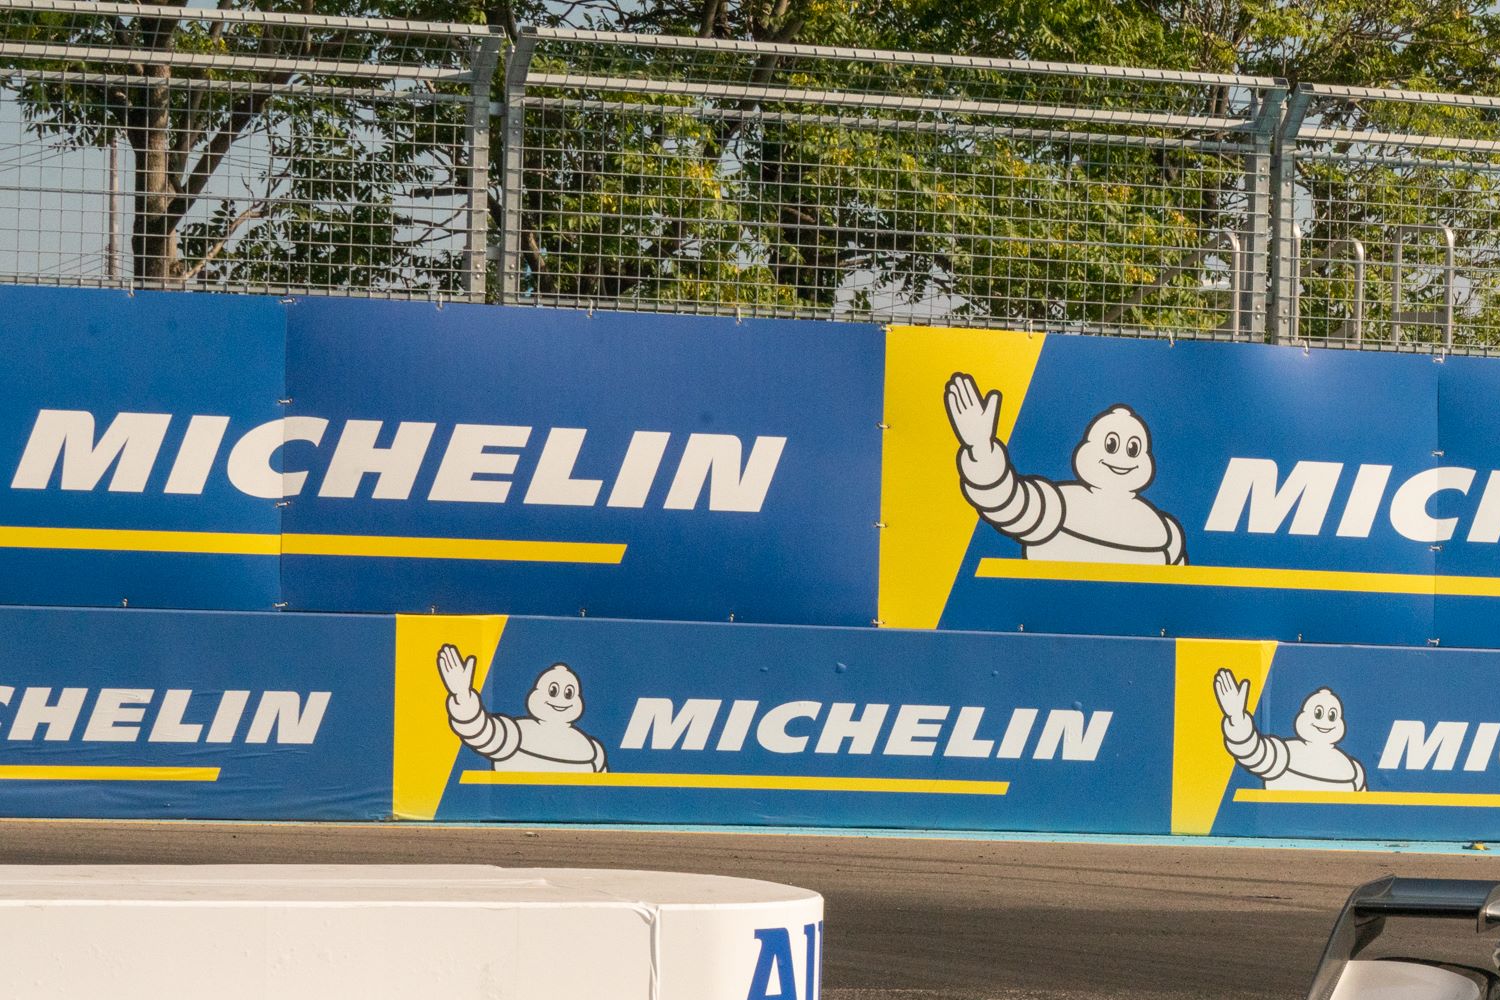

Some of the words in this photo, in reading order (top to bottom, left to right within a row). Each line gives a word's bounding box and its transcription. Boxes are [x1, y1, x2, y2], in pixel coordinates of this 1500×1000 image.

[11, 410, 787, 512] MICHELIN
[0, 686, 332, 744] HELIN
[619, 698, 1113, 761] MICHELIN
